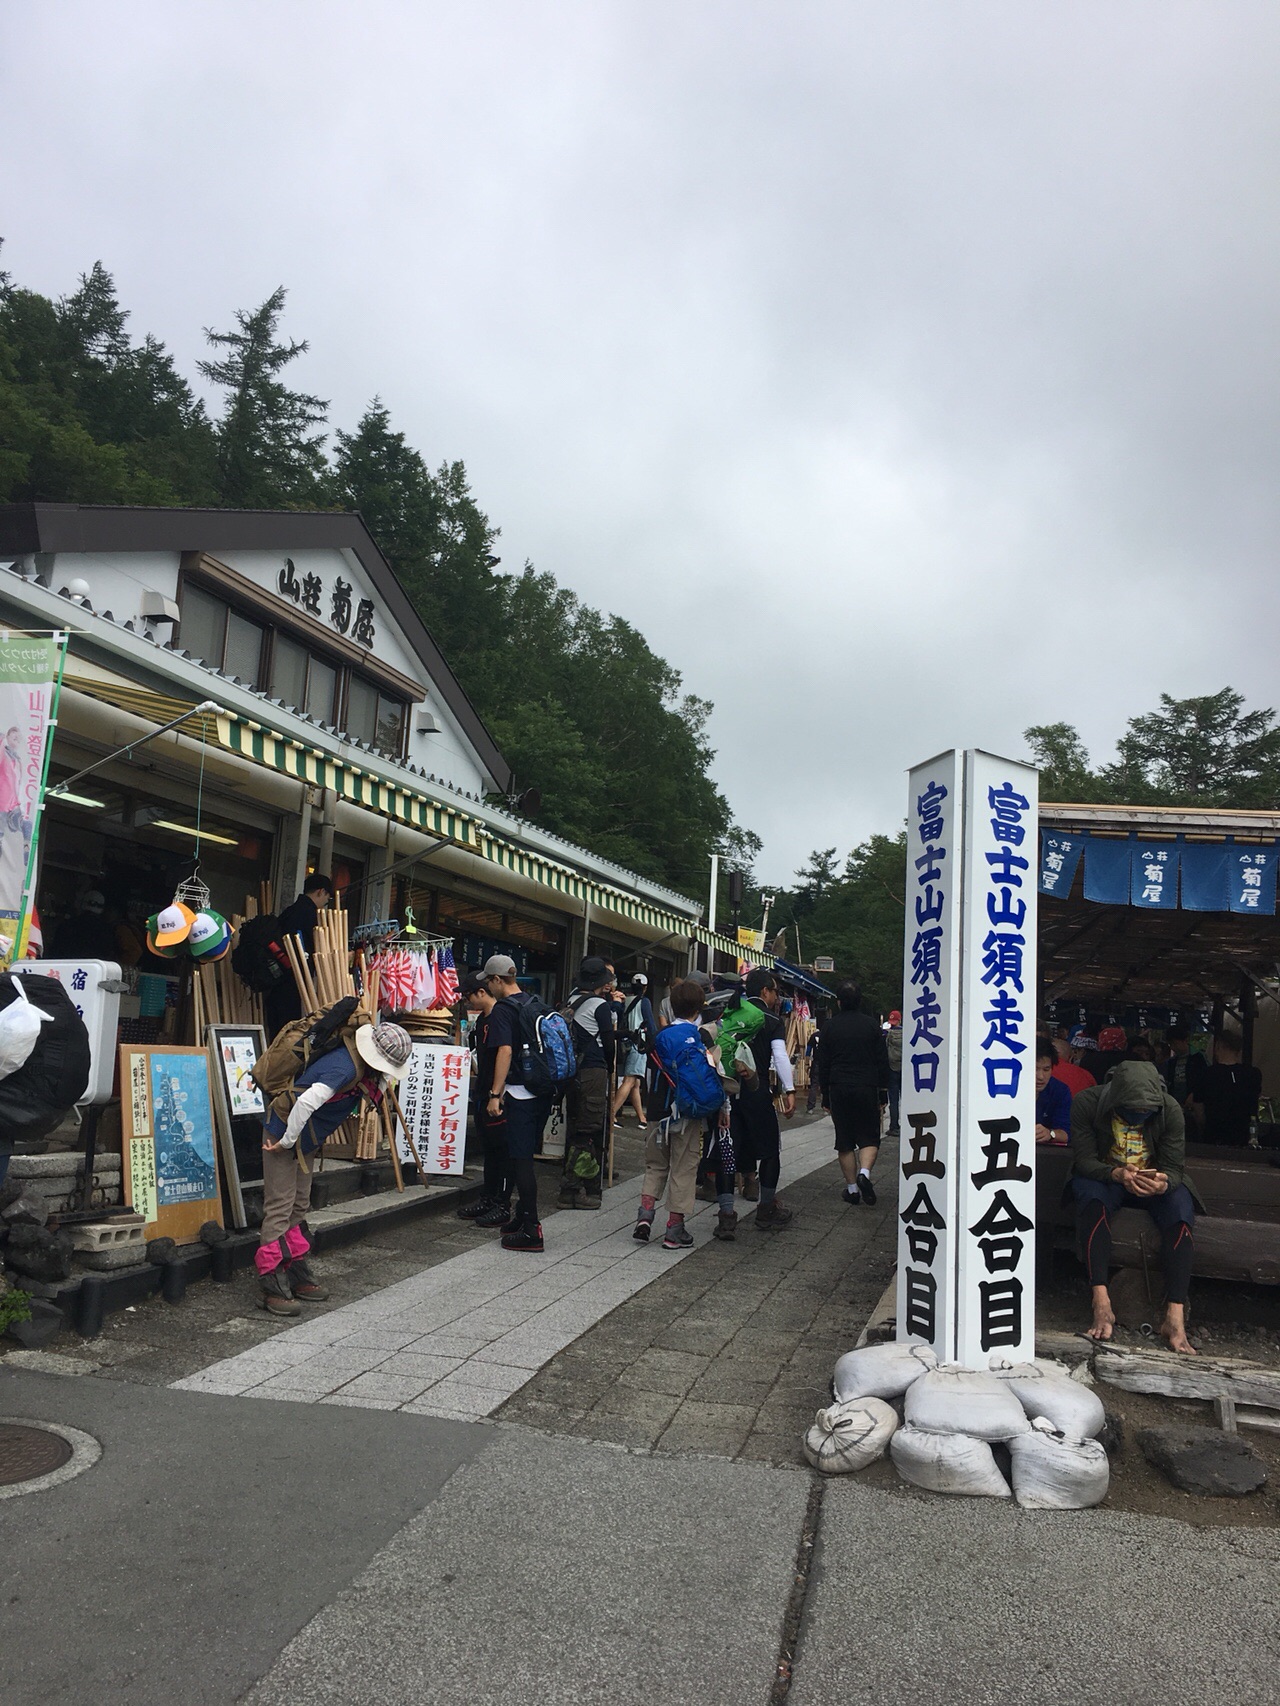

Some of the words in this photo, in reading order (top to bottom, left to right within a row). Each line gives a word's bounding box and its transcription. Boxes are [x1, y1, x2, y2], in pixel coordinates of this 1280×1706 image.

[910, 781, 948, 1092] 富士山須走口
[980, 782, 1031, 1099] 富士山須走口
[1142, 864, 1164, 903] 菊屋
[1239, 867, 1262, 908] 菊屋
[418, 1053, 435, 1168] 当店ご利用のお客様は無料です
[436, 1053, 463, 1171] 有料トイレ有ります
[900, 1110, 947, 1345] 五合目
[968, 1115, 1035, 1352] 五合目
